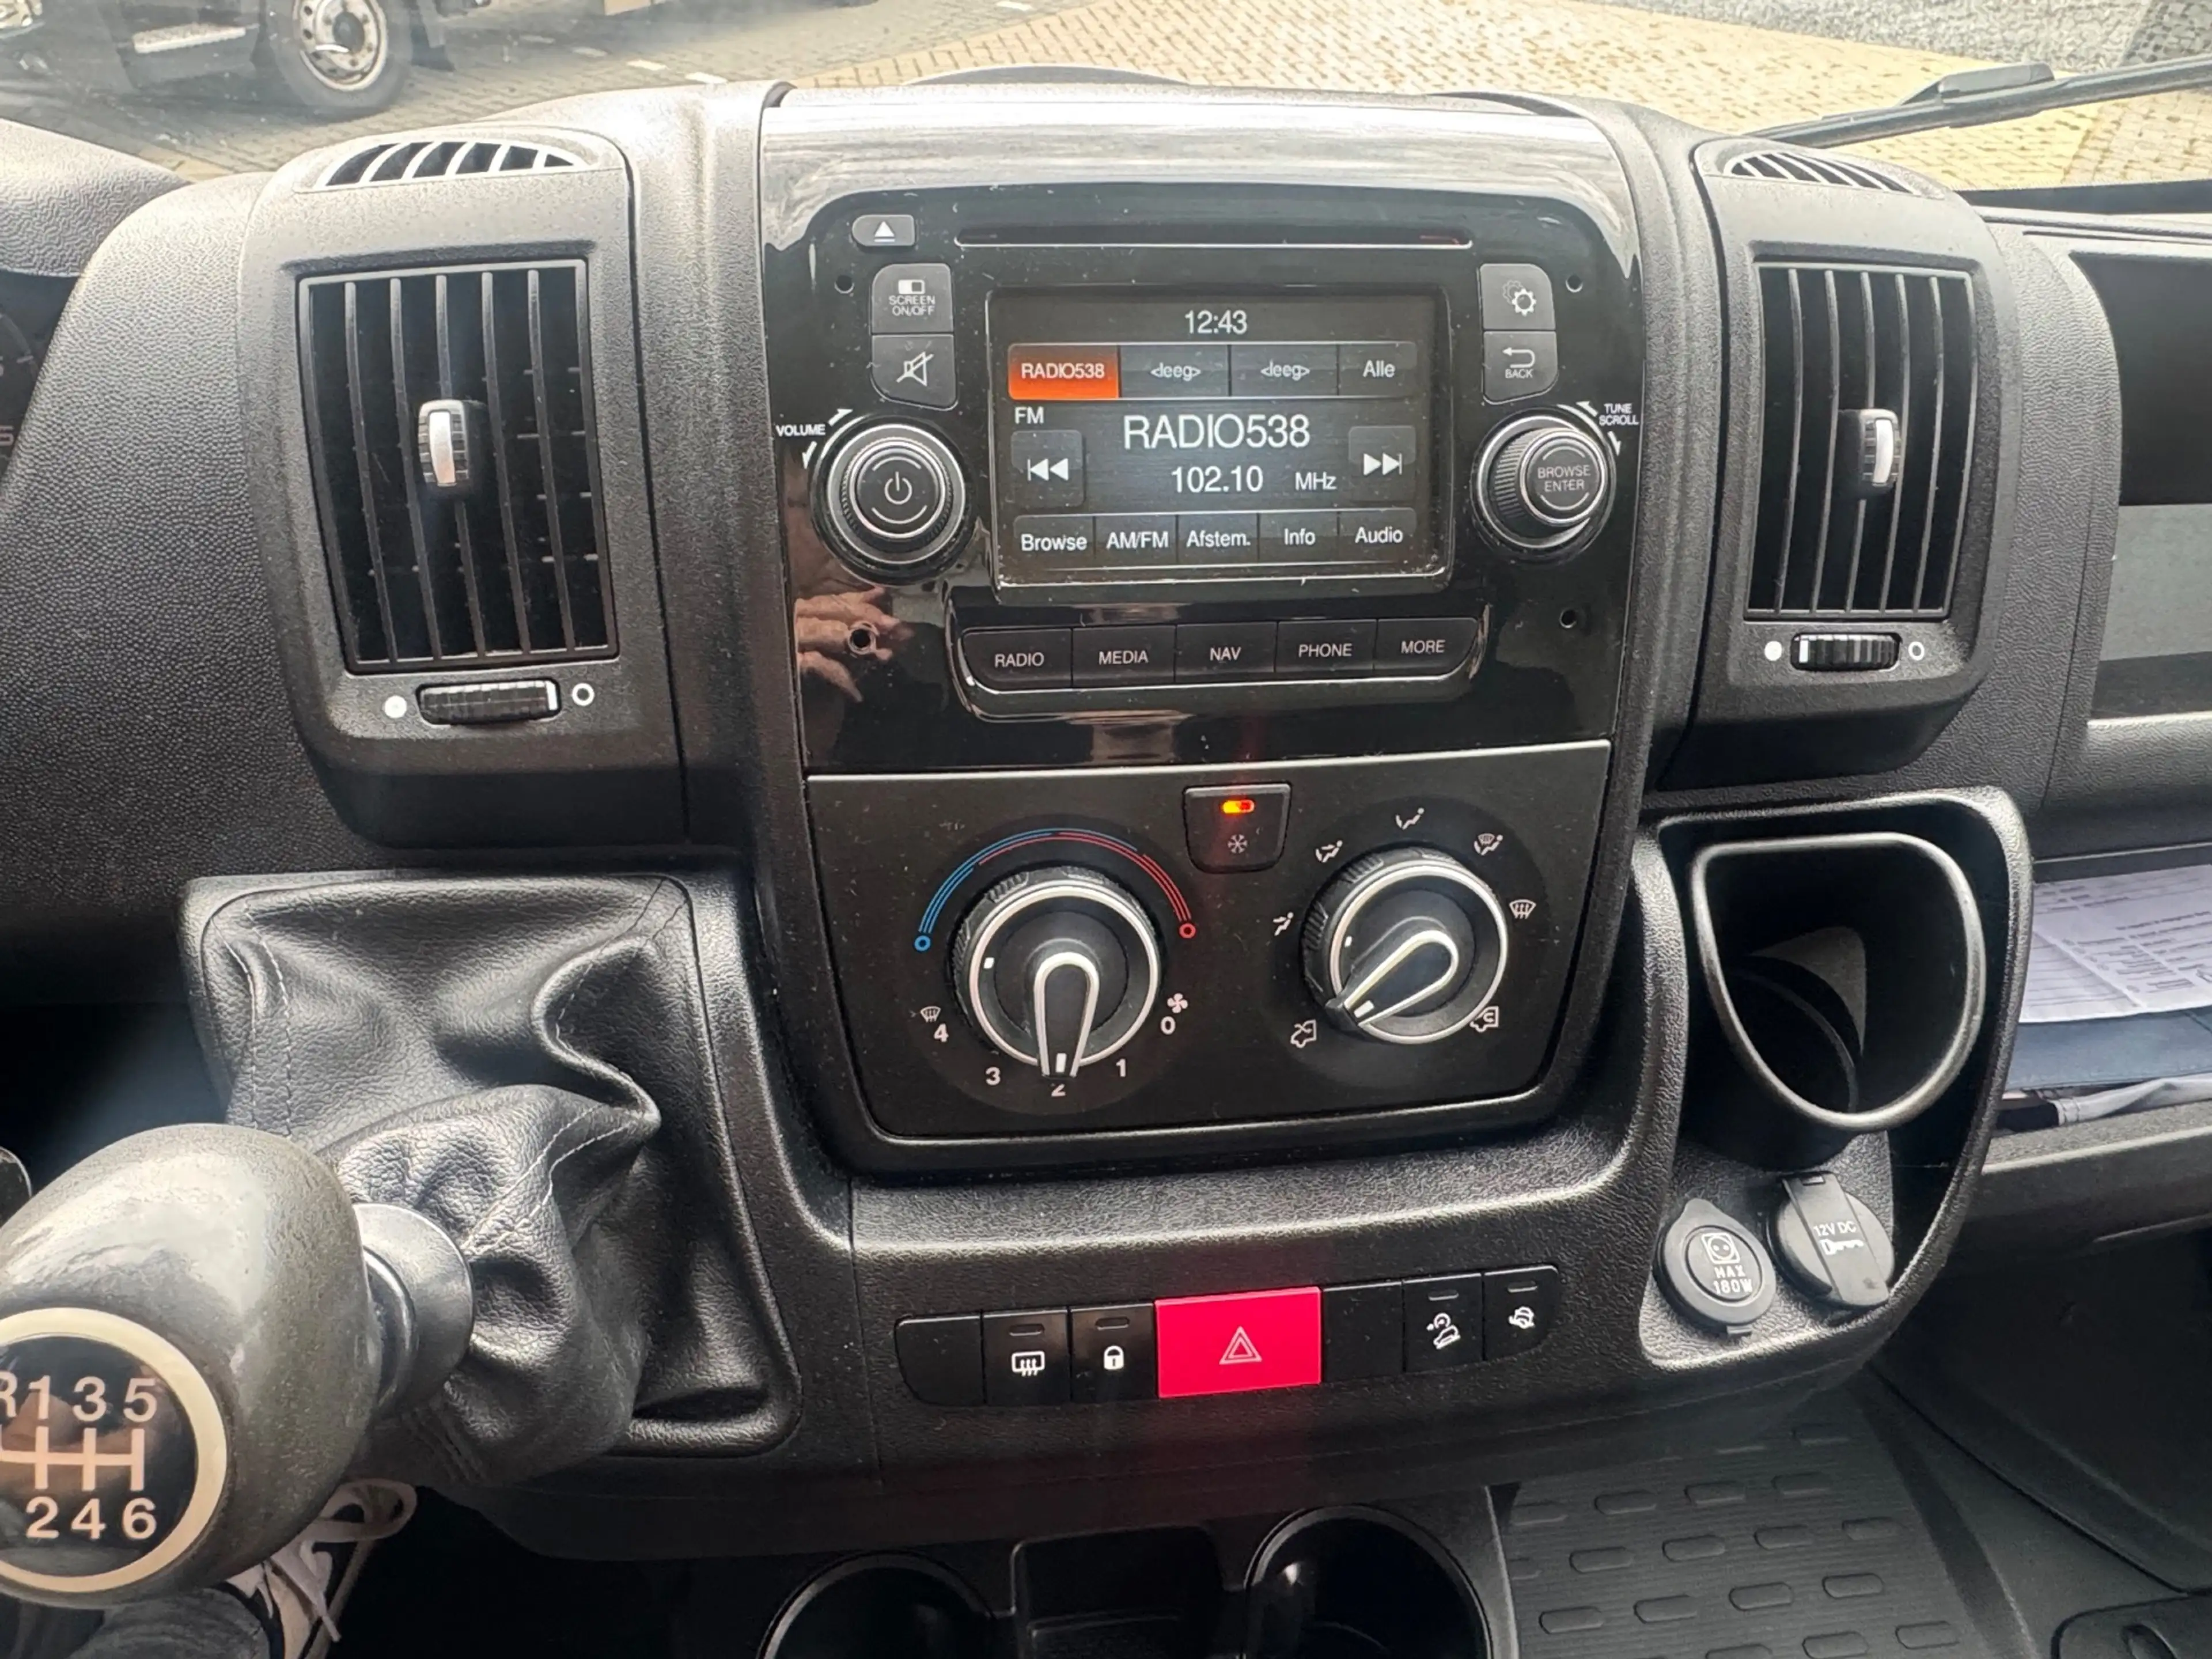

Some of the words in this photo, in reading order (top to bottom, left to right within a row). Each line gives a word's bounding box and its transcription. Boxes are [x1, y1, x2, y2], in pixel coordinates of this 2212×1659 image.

[889, 296, 935, 305] SCREEN
[892, 306, 935, 316] ON/OFF
[1185, 310, 1248, 334] 12:43
[1021, 362, 1105, 380] RADIO538
[1363, 360, 1395, 378] Alle
[1505, 369, 1533, 379] BACK
[1014, 407, 1044, 425] FM
[1604, 404, 1632, 414] TUNE
[1599, 414, 1639, 426] SCROLL
[776, 424, 825, 437] VOLUME
[1123, 414, 1310, 450] RADIO538
[1171, 466, 1263, 494] 102.10
[1295, 472, 1337, 491] MHz
[1537, 464, 1591, 479] BROWSE
[1544, 479, 1585, 493] ENTER
[1021, 533, 1087, 551] Browse
[1106, 531, 1169, 550] AM/FM
[1186, 529, 1251, 548] Afstem.
[1283, 527, 1316, 547] Info
[1354, 525, 1403, 544] Audio
[1210, 646, 1241, 662] NAV
[1298, 642, 1353, 658] PHONE
[1400, 638, 1445, 655] MORE
[994, 652, 1044, 668] RADIO
[1098, 649, 1149, 665] MEDIA
[933, 1024, 949, 1042] 4
[1160, 1016, 1176, 1034] 0
[985, 1067, 1001, 1085] 3
[1116, 1058, 1127, 1077] 1
[1051, 1084, 1066, 1097] 2
[1813, 1223, 1836, 1237] 12V
[1837, 1220, 1858, 1234] DC
[1714, 1265, 1746, 1279] MAX
[1713, 1278, 1753, 1295] 180W
[28, 1375, 51, 1419] 1
[72, 1376, 107, 1422] 3
[123, 1378, 158, 1423] 5
[26, 1497, 60, 1539] 2
[71, 1498, 106, 1539] 4
[122, 1498, 158, 1540] 6
